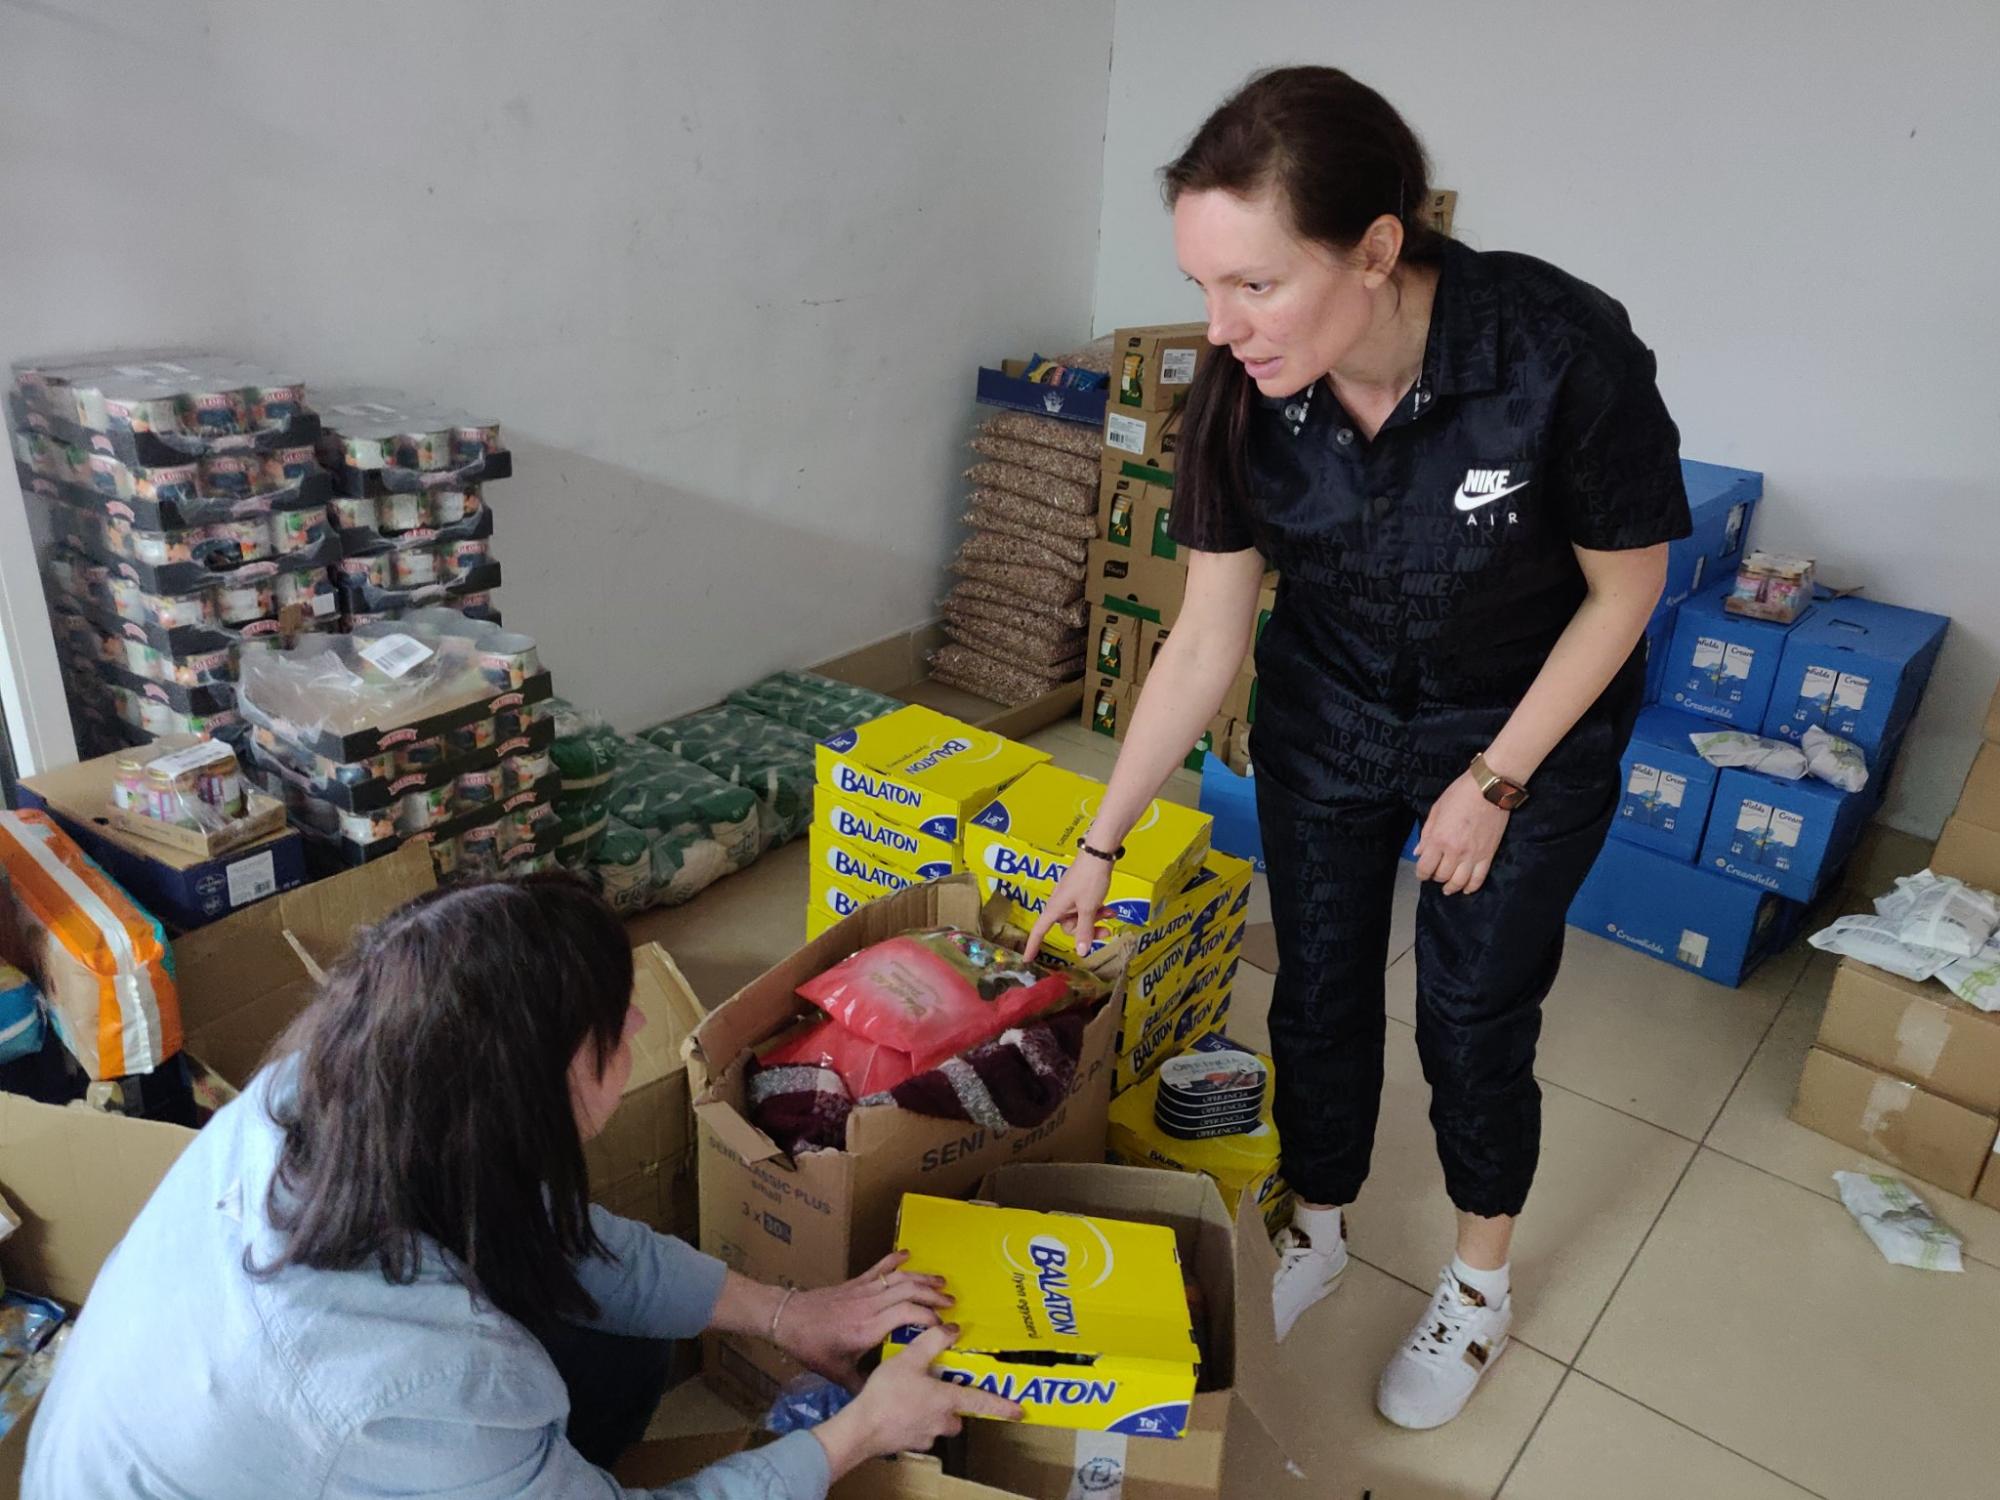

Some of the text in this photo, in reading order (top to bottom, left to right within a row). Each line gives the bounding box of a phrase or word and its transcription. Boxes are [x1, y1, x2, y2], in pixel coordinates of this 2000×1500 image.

[1463, 470, 1510, 493] NIKE
[1466, 513, 1519, 527] AIR
[904, 739, 968, 776] BALATON
[840, 766, 923, 809] BALATON
[838, 811, 919, 855] BALATON
[1725, 863, 1780, 889] Creamfields
[1117, 903, 1133, 920] Tej
[1137, 911, 1195, 955] BALATON
[1141, 944, 1185, 998] BALATON
[1132, 1018, 1174, 1073] BALATON
[921, 1129, 985, 1172] SENI
[794, 1188, 832, 1216] PLUS
[1030, 1244, 1079, 1336] BALATON
[1139, 1416, 1160, 1432] Tej
